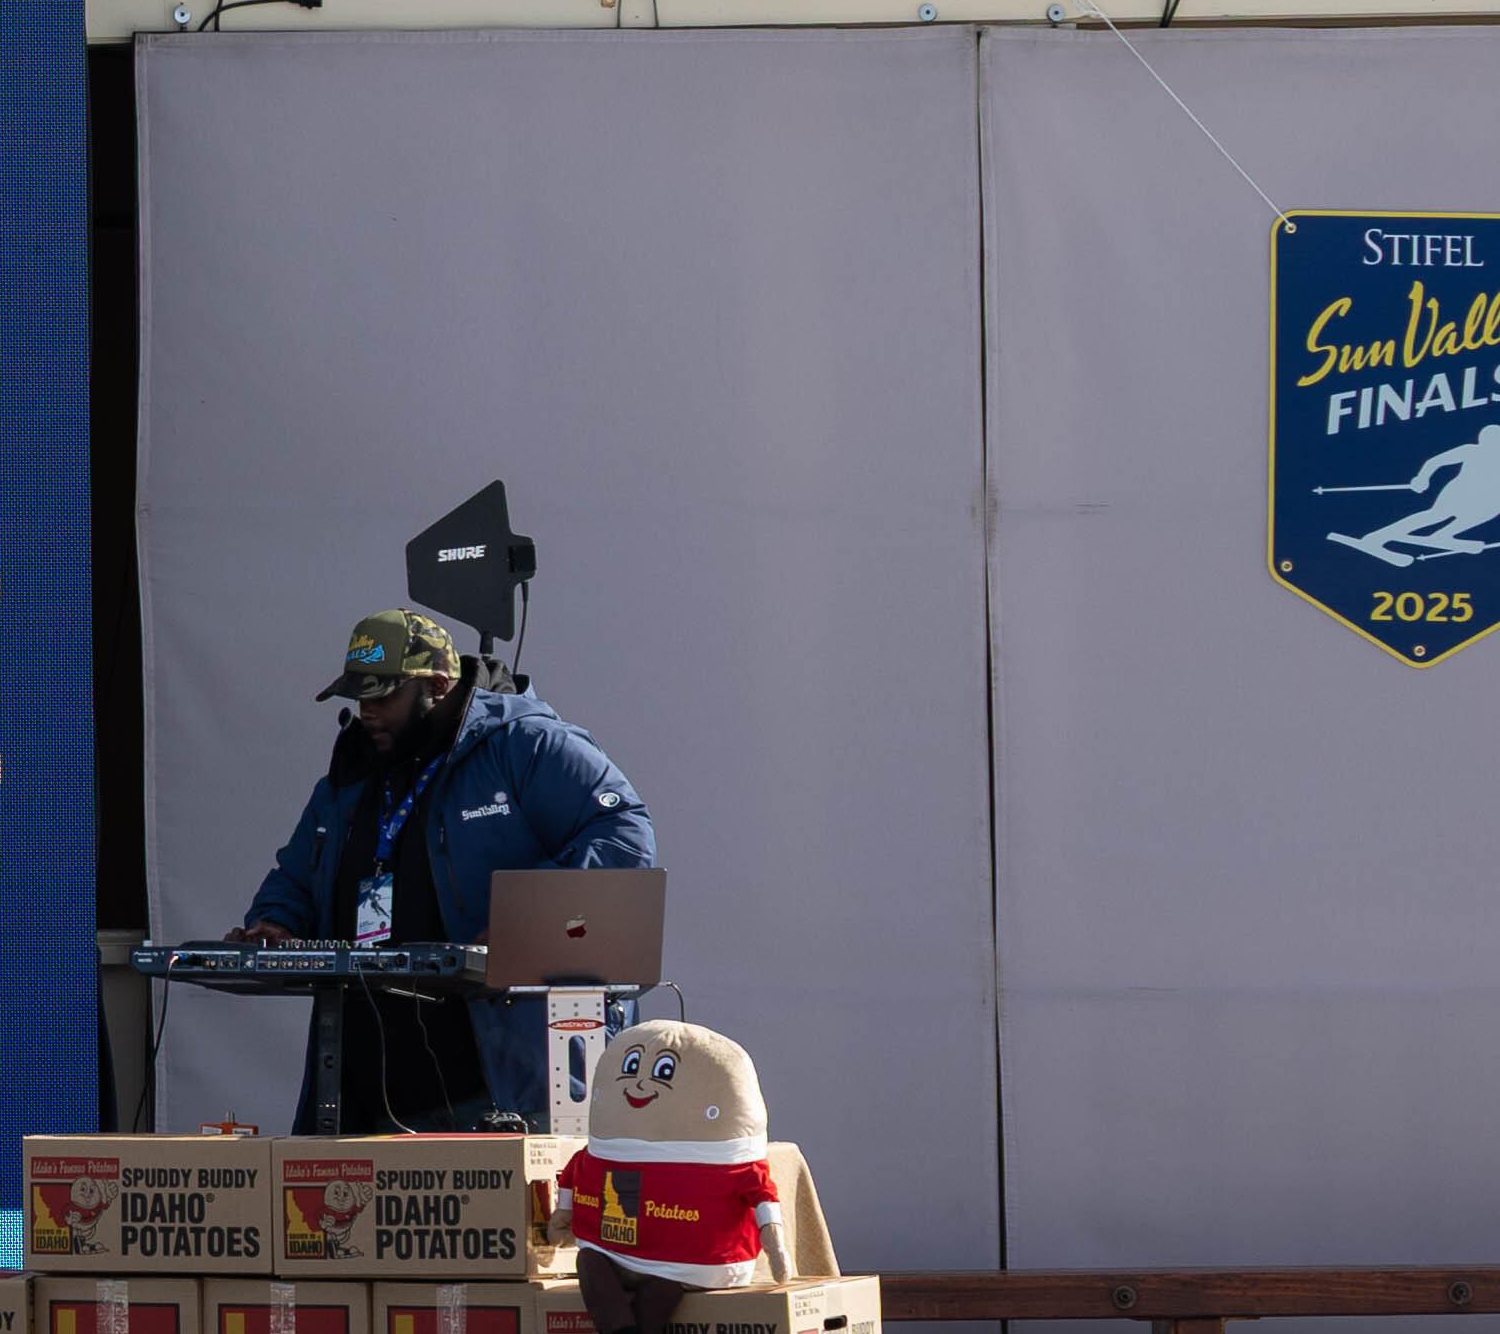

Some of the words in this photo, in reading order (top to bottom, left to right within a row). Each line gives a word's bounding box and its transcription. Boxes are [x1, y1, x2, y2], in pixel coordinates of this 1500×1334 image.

[1362, 228, 1484, 267] STIFEL
[438, 545, 487, 563] SHURE
[1371, 592, 1474, 622] 2025
[122, 1168, 192, 1188] SPUDDY
[197, 1168, 258, 1189] BUDDY
[376, 1170, 447, 1190] SPUDDY
[452, 1170, 514, 1190] BUDDY
[644, 1200, 700, 1221] Potatoes
[121, 1226, 260, 1258] POTATOES
[602, 1223, 635, 1243] IDAHO
[376, 1228, 516, 1260] POTATOES
